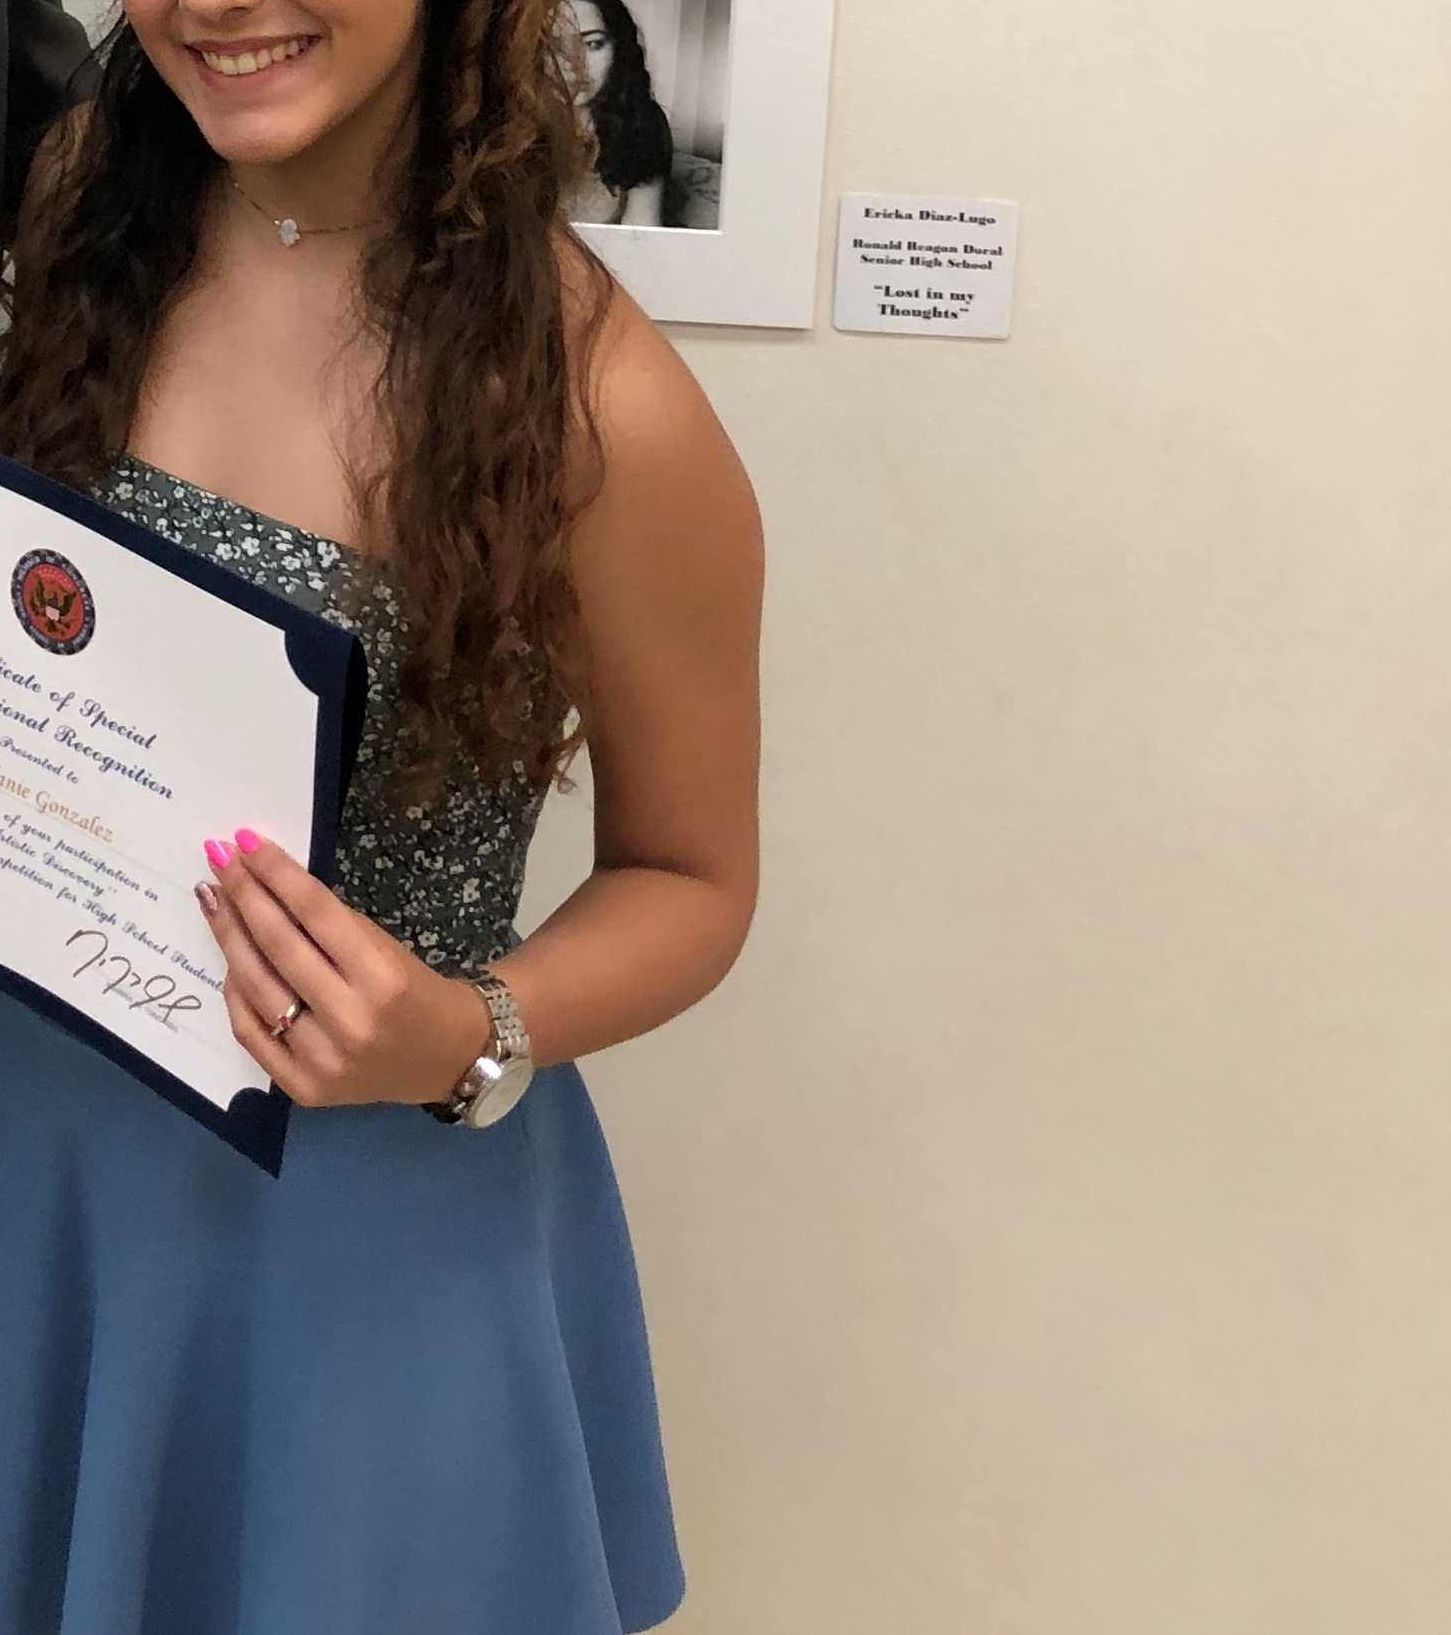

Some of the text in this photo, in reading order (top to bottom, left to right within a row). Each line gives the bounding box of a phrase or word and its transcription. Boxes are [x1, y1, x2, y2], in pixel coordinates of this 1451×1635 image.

[864, 207, 997, 226] Ericka Diaz-Lugo
[853, 238, 1003, 256] Ronald Reagan Doral
[860, 254, 993, 270] Senior High School
[926, 287, 943, 300] in
[950, 292, 975, 305] my
[49, 691, 76, 713] of
[79, 698, 157, 749] Special
[0, 735, 79, 784] Presented to
[53, 725, 173, 799] Recognition
[35, 790, 114, 843] Gonzalez
[3, 814, 22, 828] of
[21, 823, 52, 843] your
[53, 838, 141, 892] participation
[144, 887, 159, 902] in
[56, 886, 77, 903] for
[82, 899, 117, 926] High
[122, 919, 169, 955] School
[170, 950, 224, 992] Student
